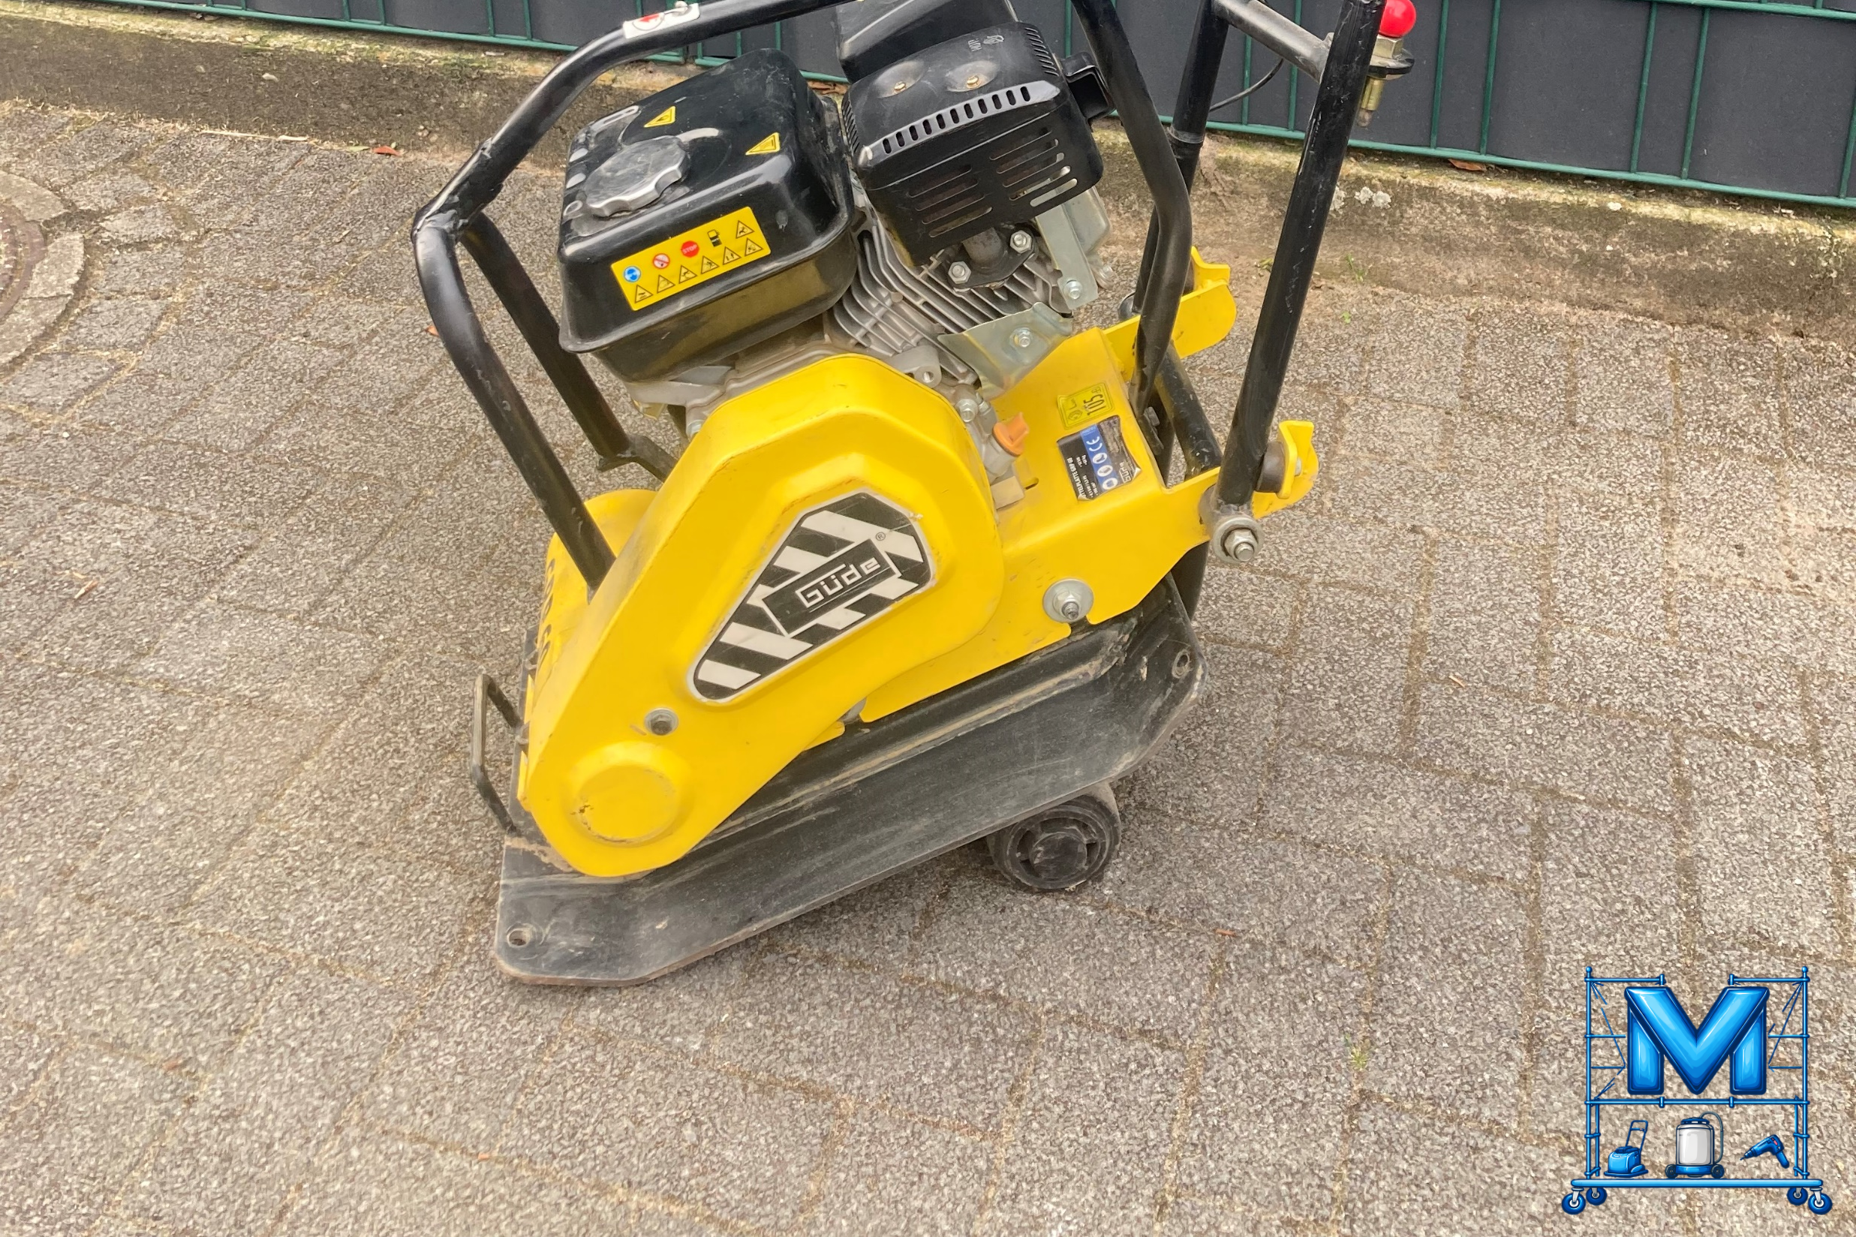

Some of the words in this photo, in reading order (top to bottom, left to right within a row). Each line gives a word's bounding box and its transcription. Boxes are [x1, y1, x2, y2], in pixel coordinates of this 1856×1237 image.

[682, 244, 698, 255] STOP
[1083, 393, 1107, 416] 105
[795, 557, 881, 608] Güde
